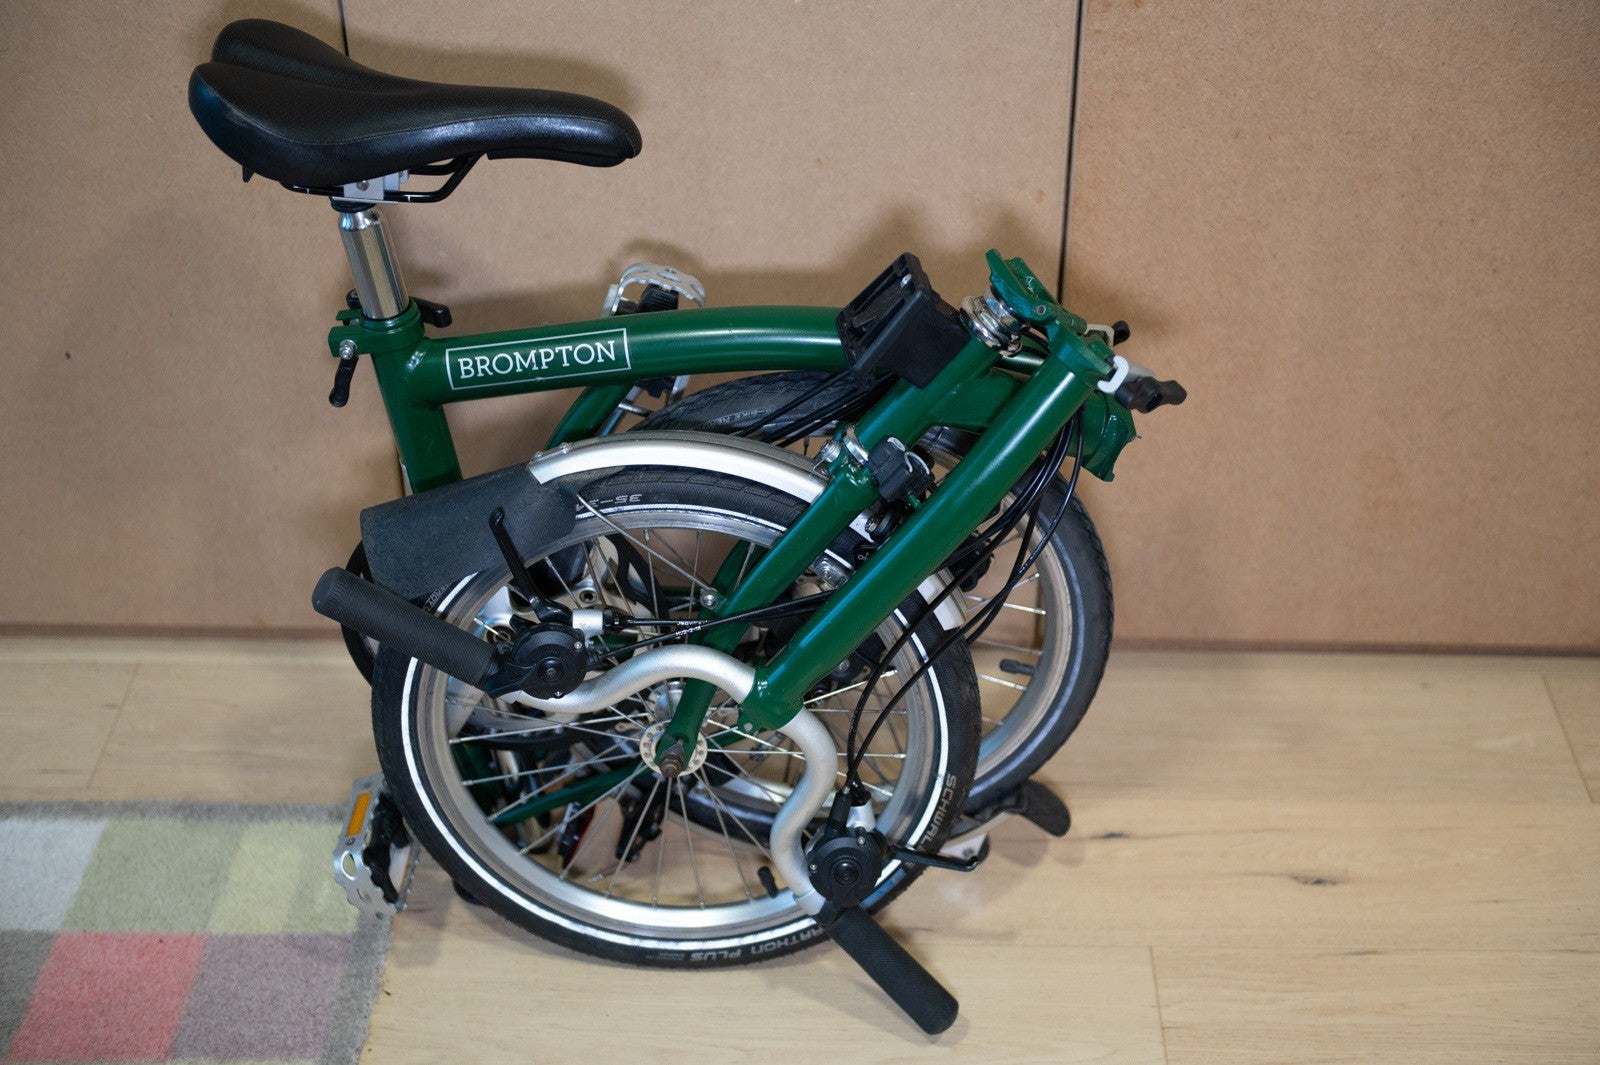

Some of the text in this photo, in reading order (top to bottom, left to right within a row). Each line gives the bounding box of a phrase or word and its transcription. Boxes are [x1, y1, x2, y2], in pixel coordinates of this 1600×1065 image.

[458, 340, 617, 379] BROMPTON
[911, 773, 957, 856] SCHWAL
[690, 948, 741, 961] PLUS
